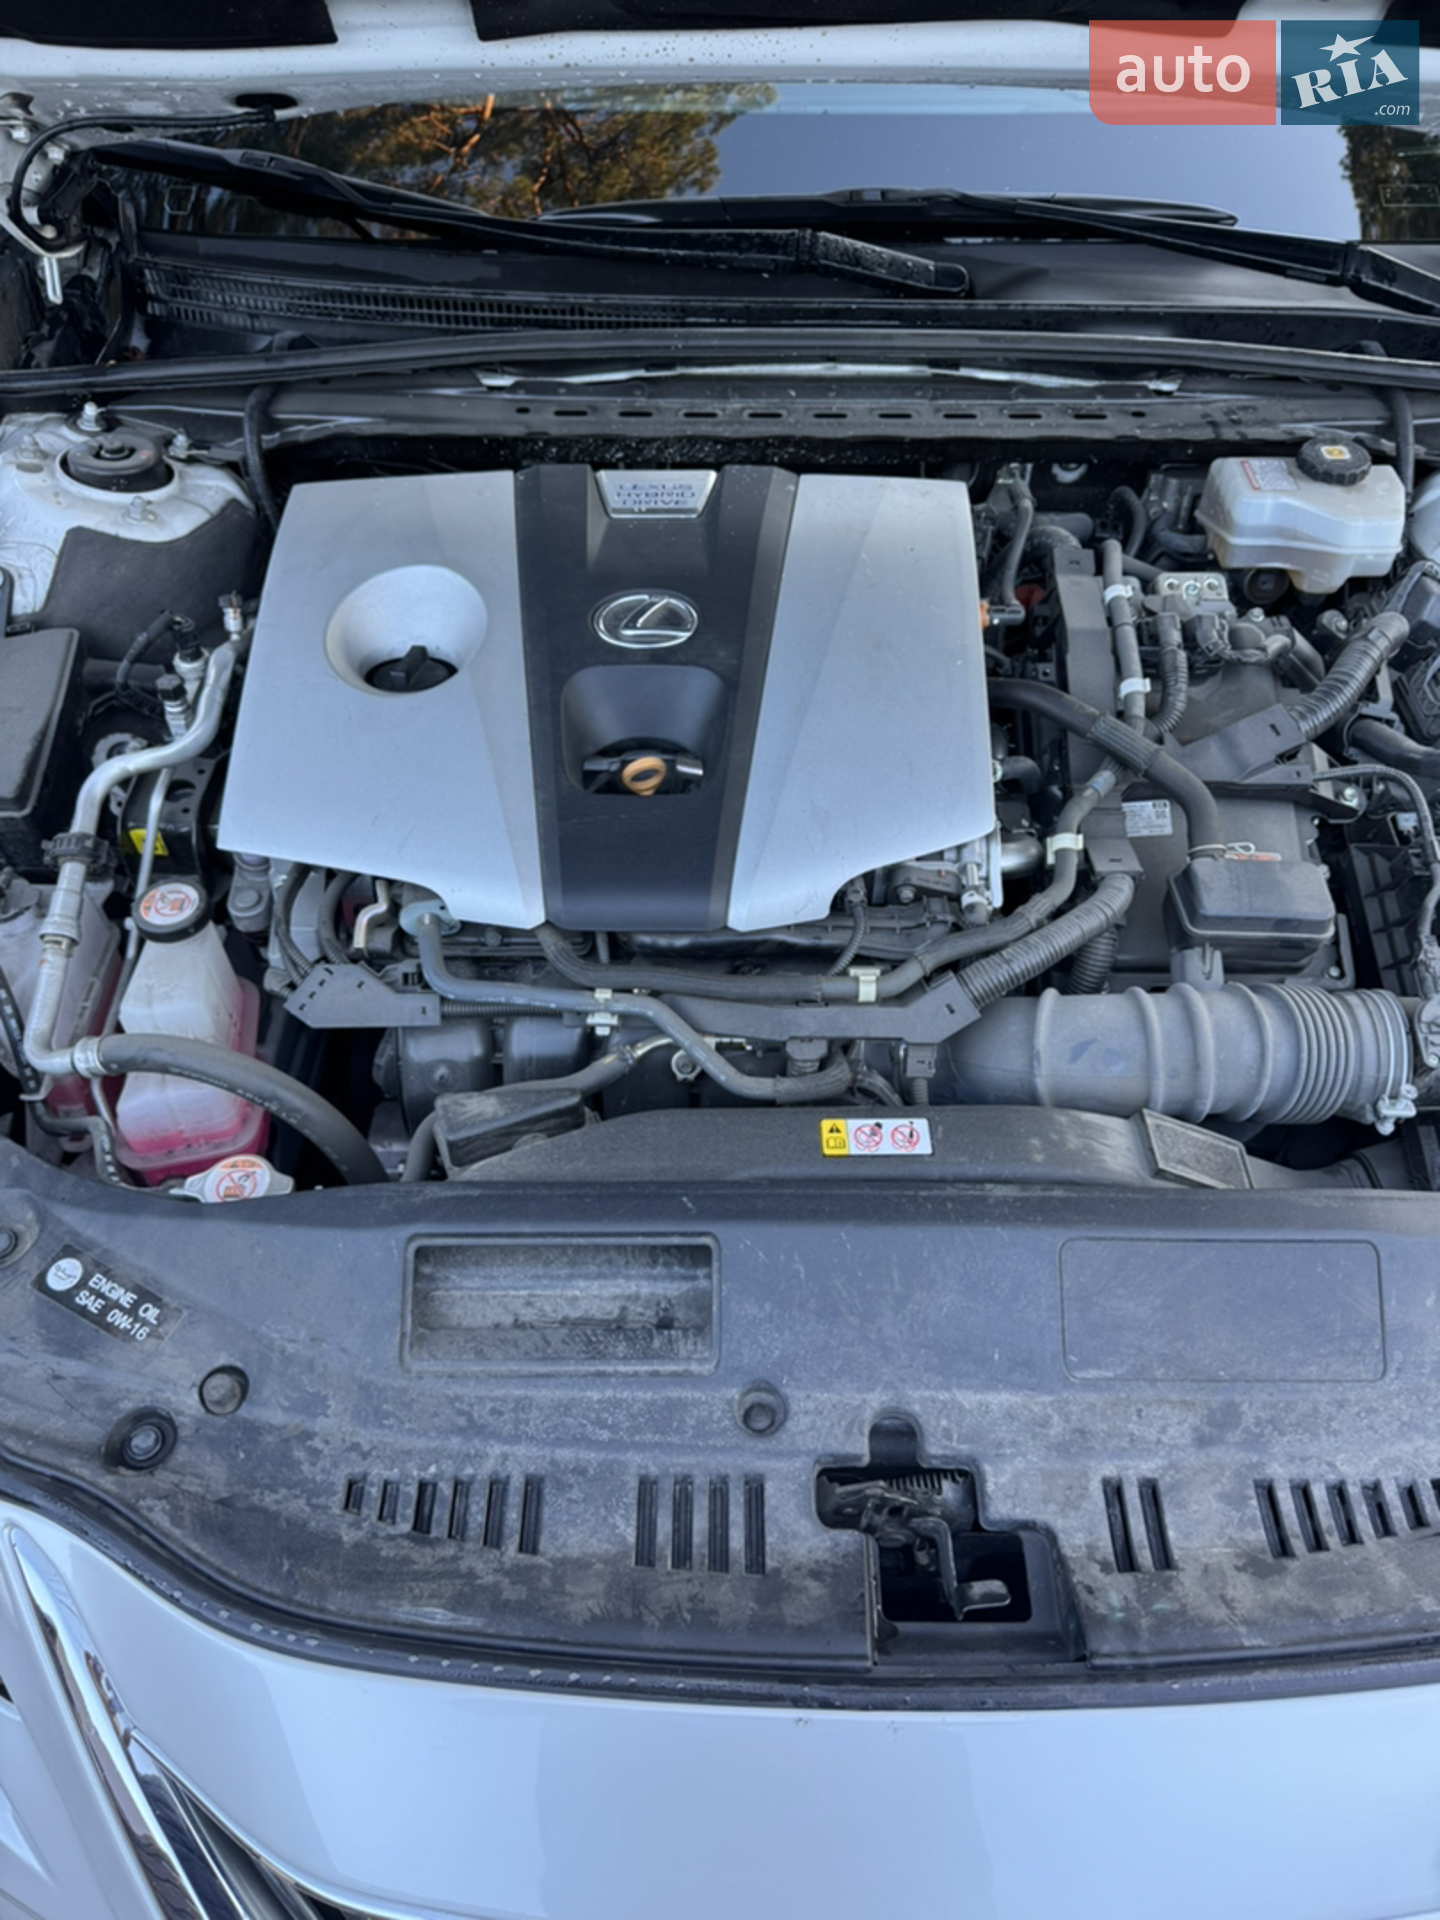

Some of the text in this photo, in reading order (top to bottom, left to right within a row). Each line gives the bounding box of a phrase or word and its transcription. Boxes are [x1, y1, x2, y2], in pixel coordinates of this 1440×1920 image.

[619, 483, 693, 491] LEXUS
[74, 1290, 150, 1342] SAE 0W-16
[88, 1273, 162, 1325] ENGINE OIL
